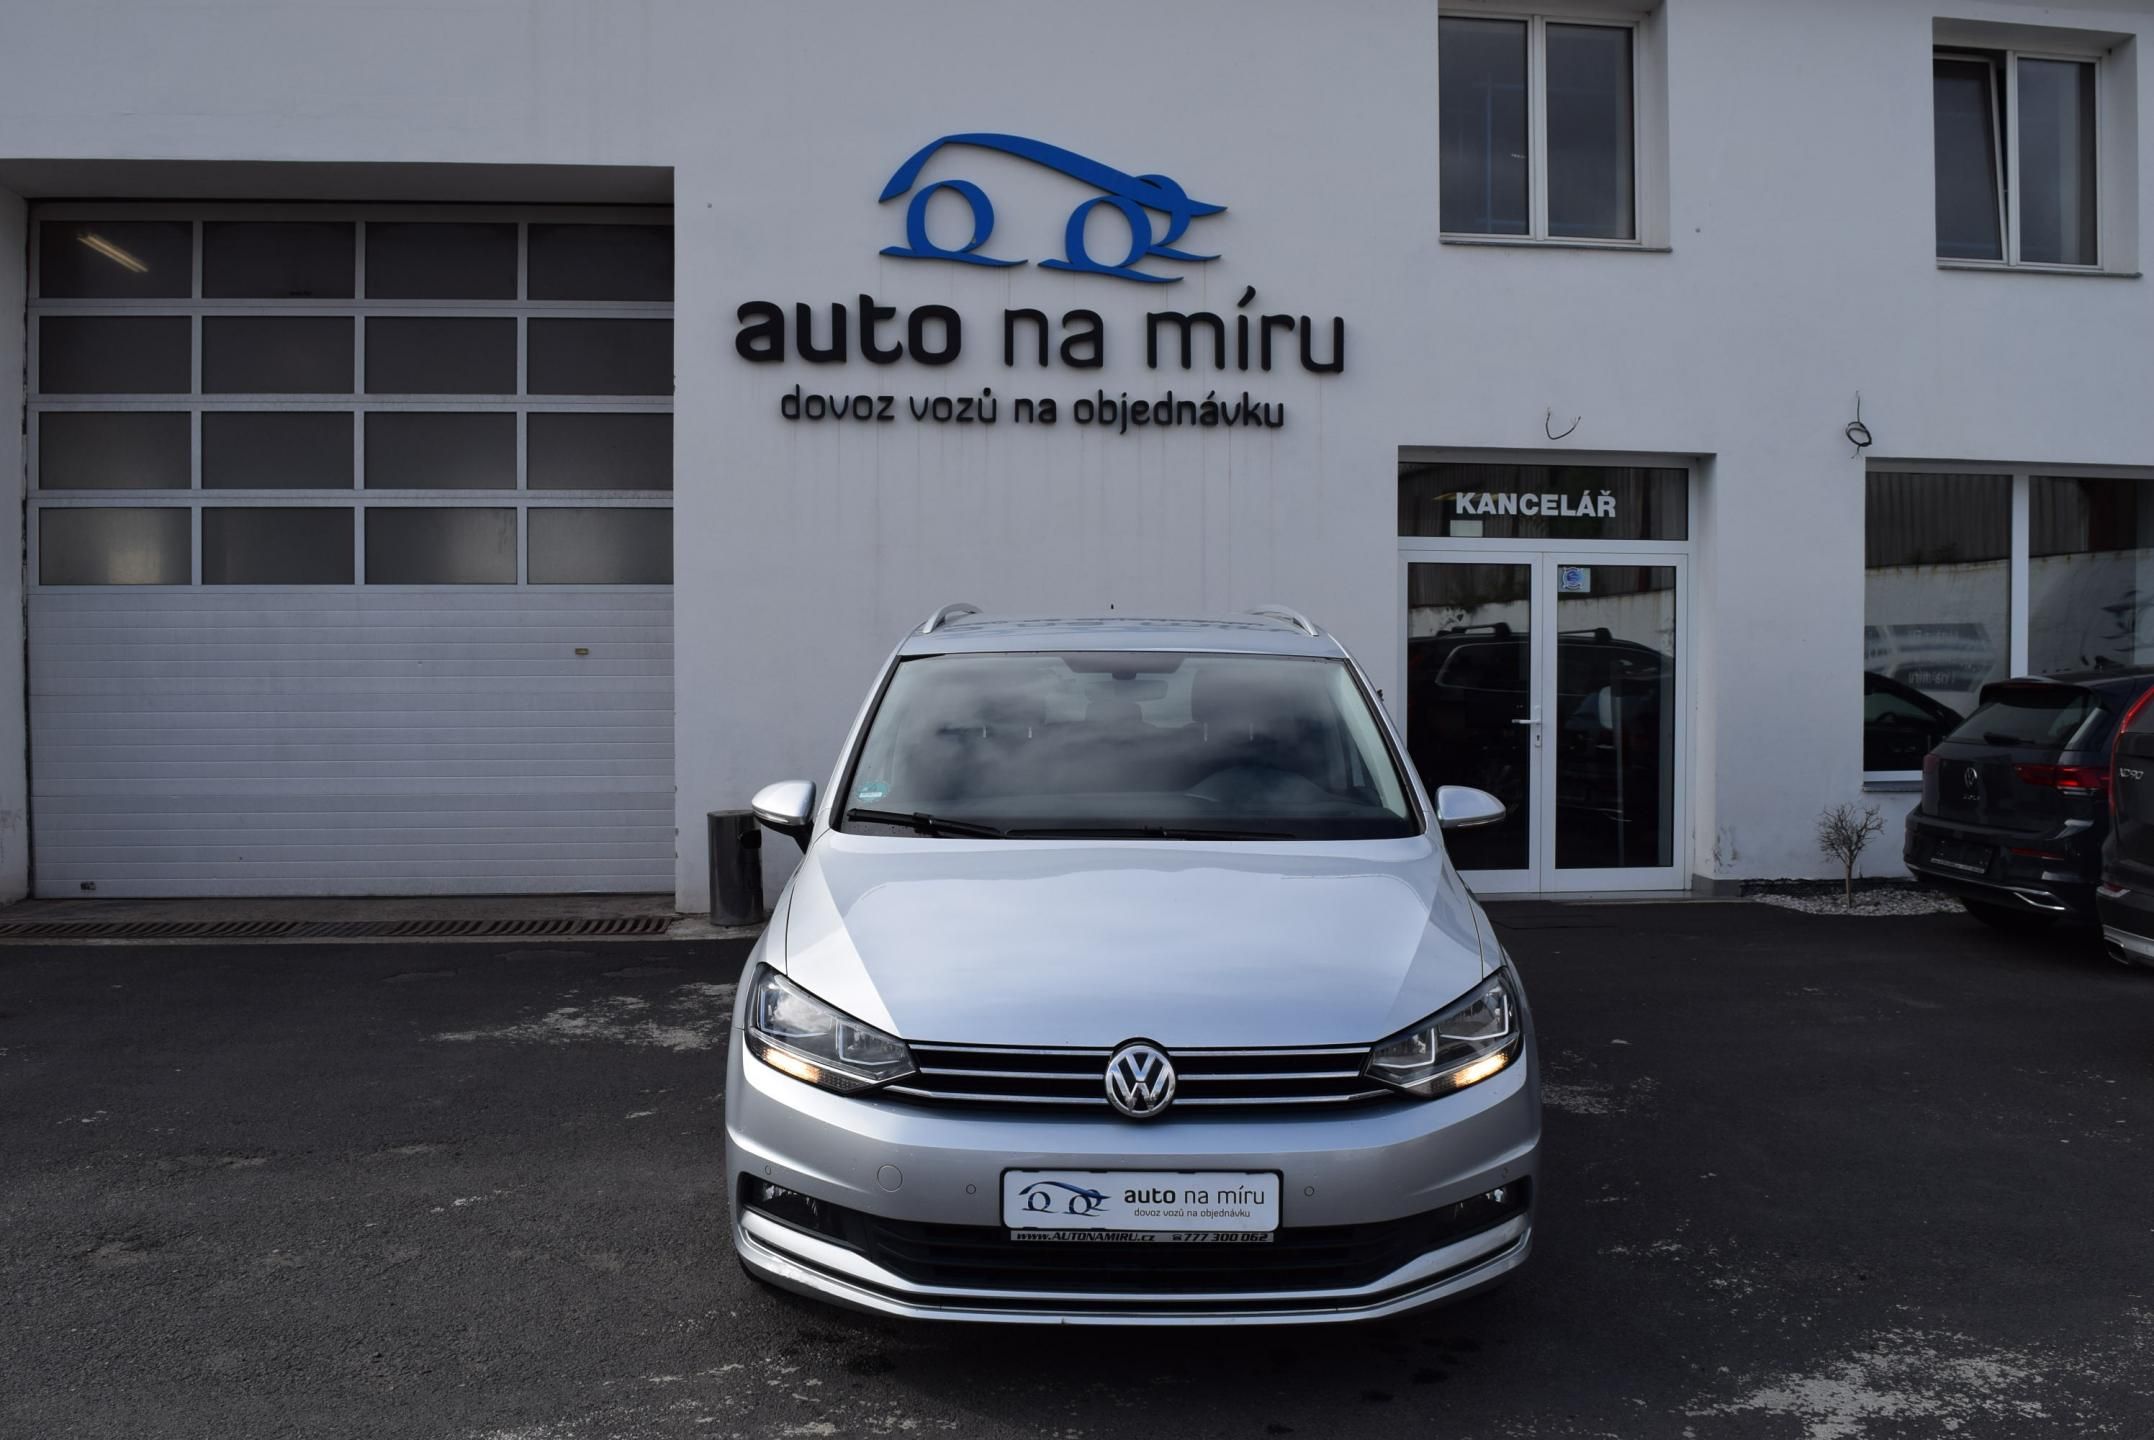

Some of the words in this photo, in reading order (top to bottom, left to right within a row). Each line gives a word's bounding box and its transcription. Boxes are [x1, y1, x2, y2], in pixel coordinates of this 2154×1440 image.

[735, 293, 961, 366] auto
[1004, 308, 1104, 368] na
[1147, 285, 1345, 373] míru
[780, 384, 895, 422] dovoz
[909, 387, 997, 423] vozů
[1013, 394, 1058, 424] na
[1073, 390, 1285, 434] objednávku
[1456, 490, 1617, 518] KANCELÁŘ
[1106, 1046, 1175, 1117] VW
[1124, 1187, 1176, 1204] auto
[1184, 1189, 1209, 1204] na
[1217, 1184, 1265, 1205] míru
[1134, 1207, 1161, 1217] dovoz
[1200, 1208, 1251, 1219] objednávku
[1212, 1232, 1240, 1242] 300
